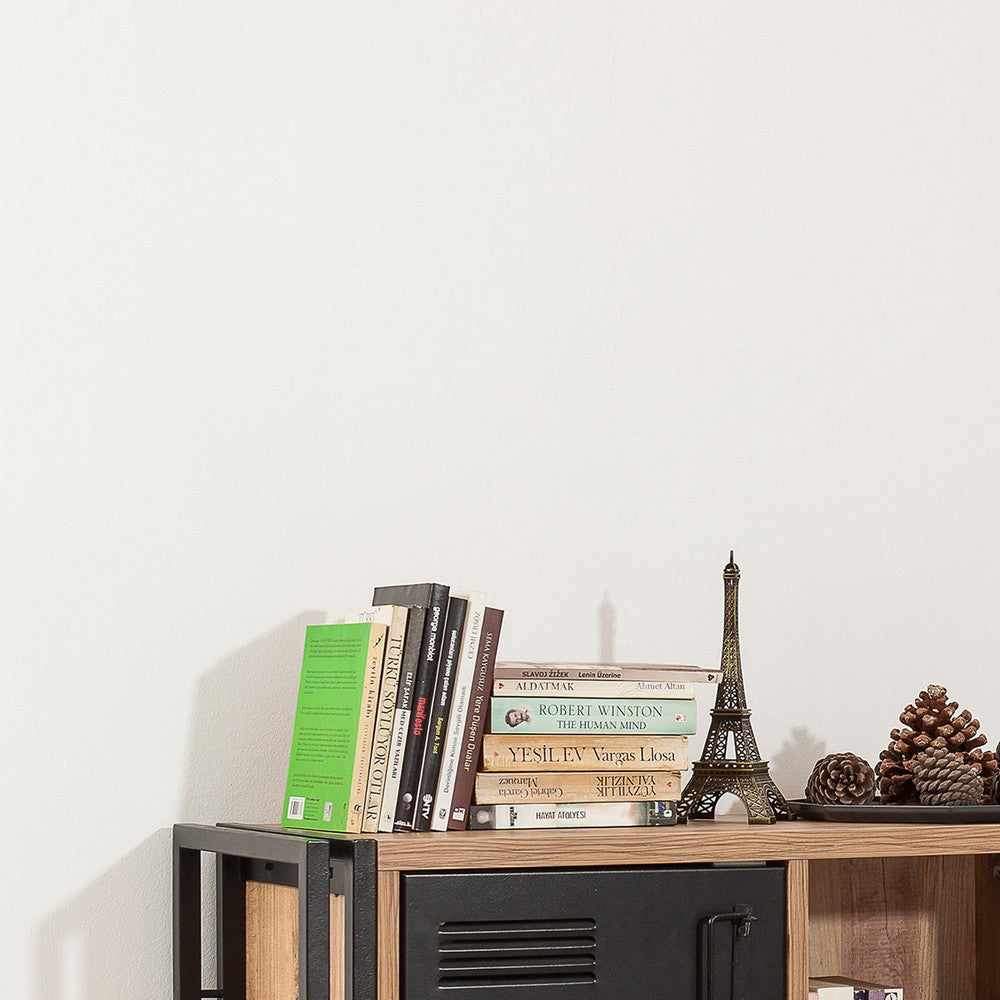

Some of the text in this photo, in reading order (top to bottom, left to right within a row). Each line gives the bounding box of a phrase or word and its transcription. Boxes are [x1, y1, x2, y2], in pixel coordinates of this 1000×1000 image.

[427, 606, 440, 662] george monbiot
[386, 636, 403, 687] TÜRKÜ
[477, 632, 493, 691] SEMA KAYGUSUZ
[516, 682, 685, 691] ALDATMAK Ahmet Altan
[474, 696, 484, 713] Yere
[539, 704, 663, 717] ROBERT WINSTON
[413, 697, 426, 736] manifesto
[557, 720, 647, 730] THE HUMAN MIND
[464, 744, 475, 771] Dualar
[508, 744, 675, 765] YEŞİL EV Vargas Llosa
[499, 776, 656, 787] YALNIZLIK Marquez
[366, 769, 384, 820] OTLAR
[530, 788, 563, 797] Gabriel
[597, 786, 656, 797] YÜZYILLIK
[422, 800, 431, 819] NTV
